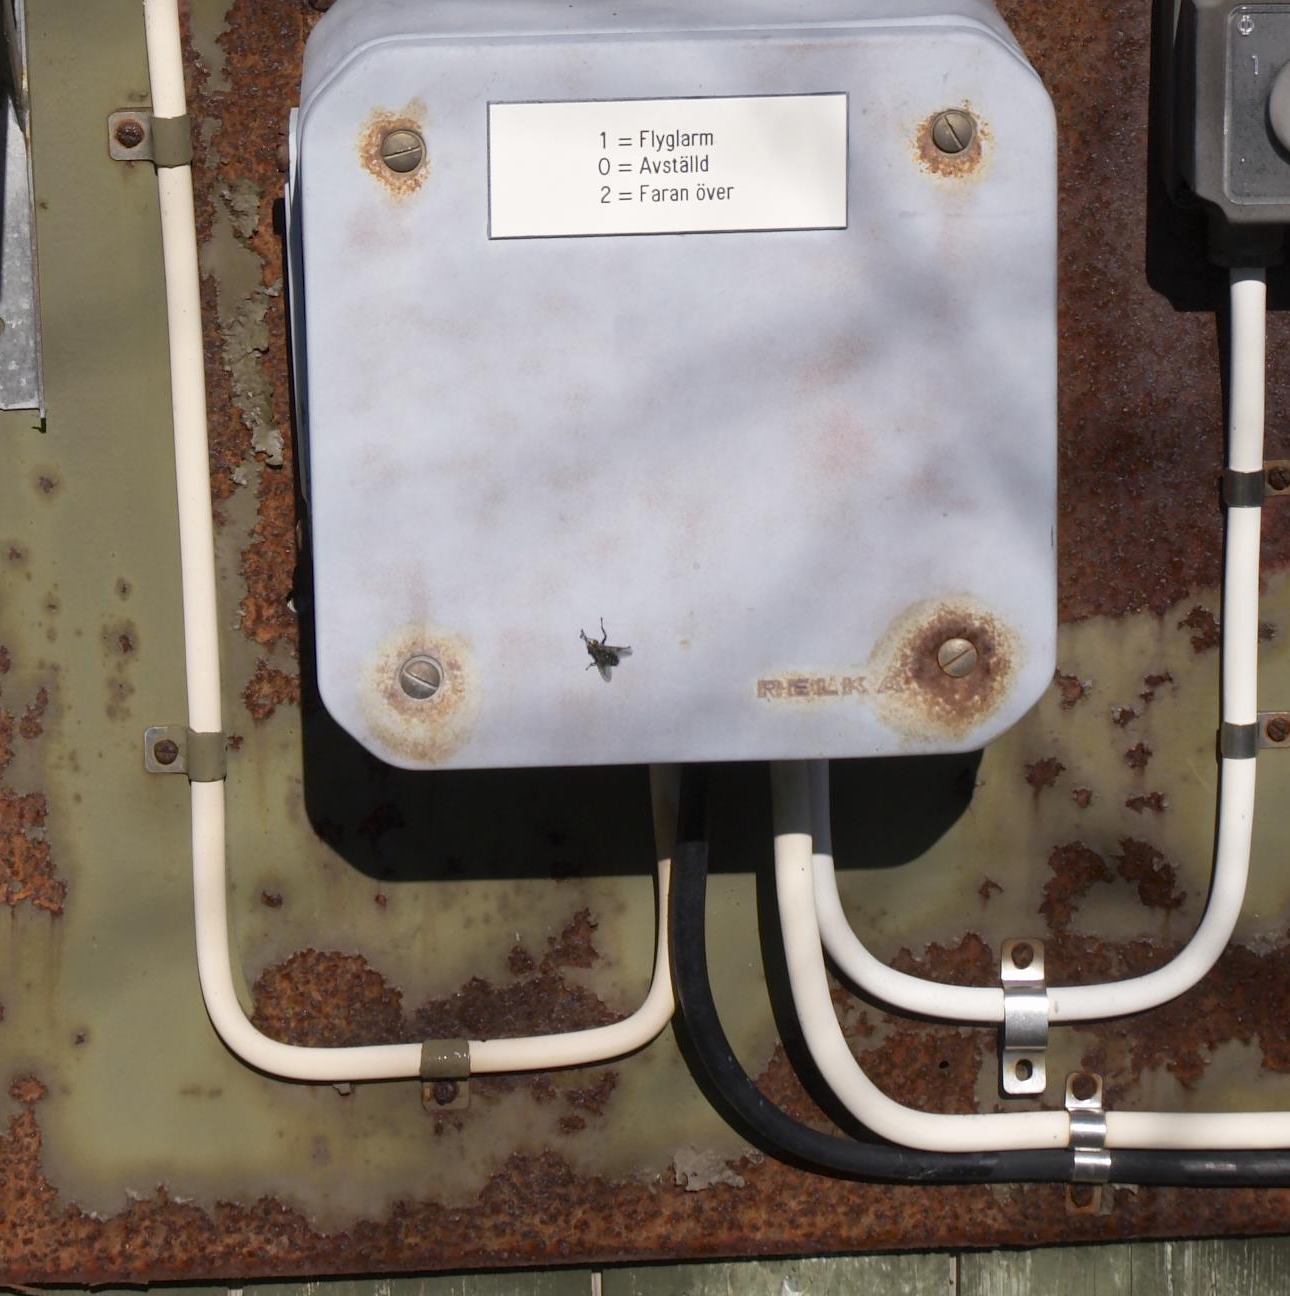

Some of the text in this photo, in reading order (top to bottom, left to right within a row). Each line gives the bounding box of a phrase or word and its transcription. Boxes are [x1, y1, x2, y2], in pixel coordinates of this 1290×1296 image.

[1251, 55, 1260, 75] 1
[599, 131, 607, 149] 1
[639, 130, 714, 152] Flyglarm
[639, 155, 710, 175] Avställd
[600, 185, 611, 203] 2
[639, 184, 689, 202] Faran
[695, 183, 735, 202] över
